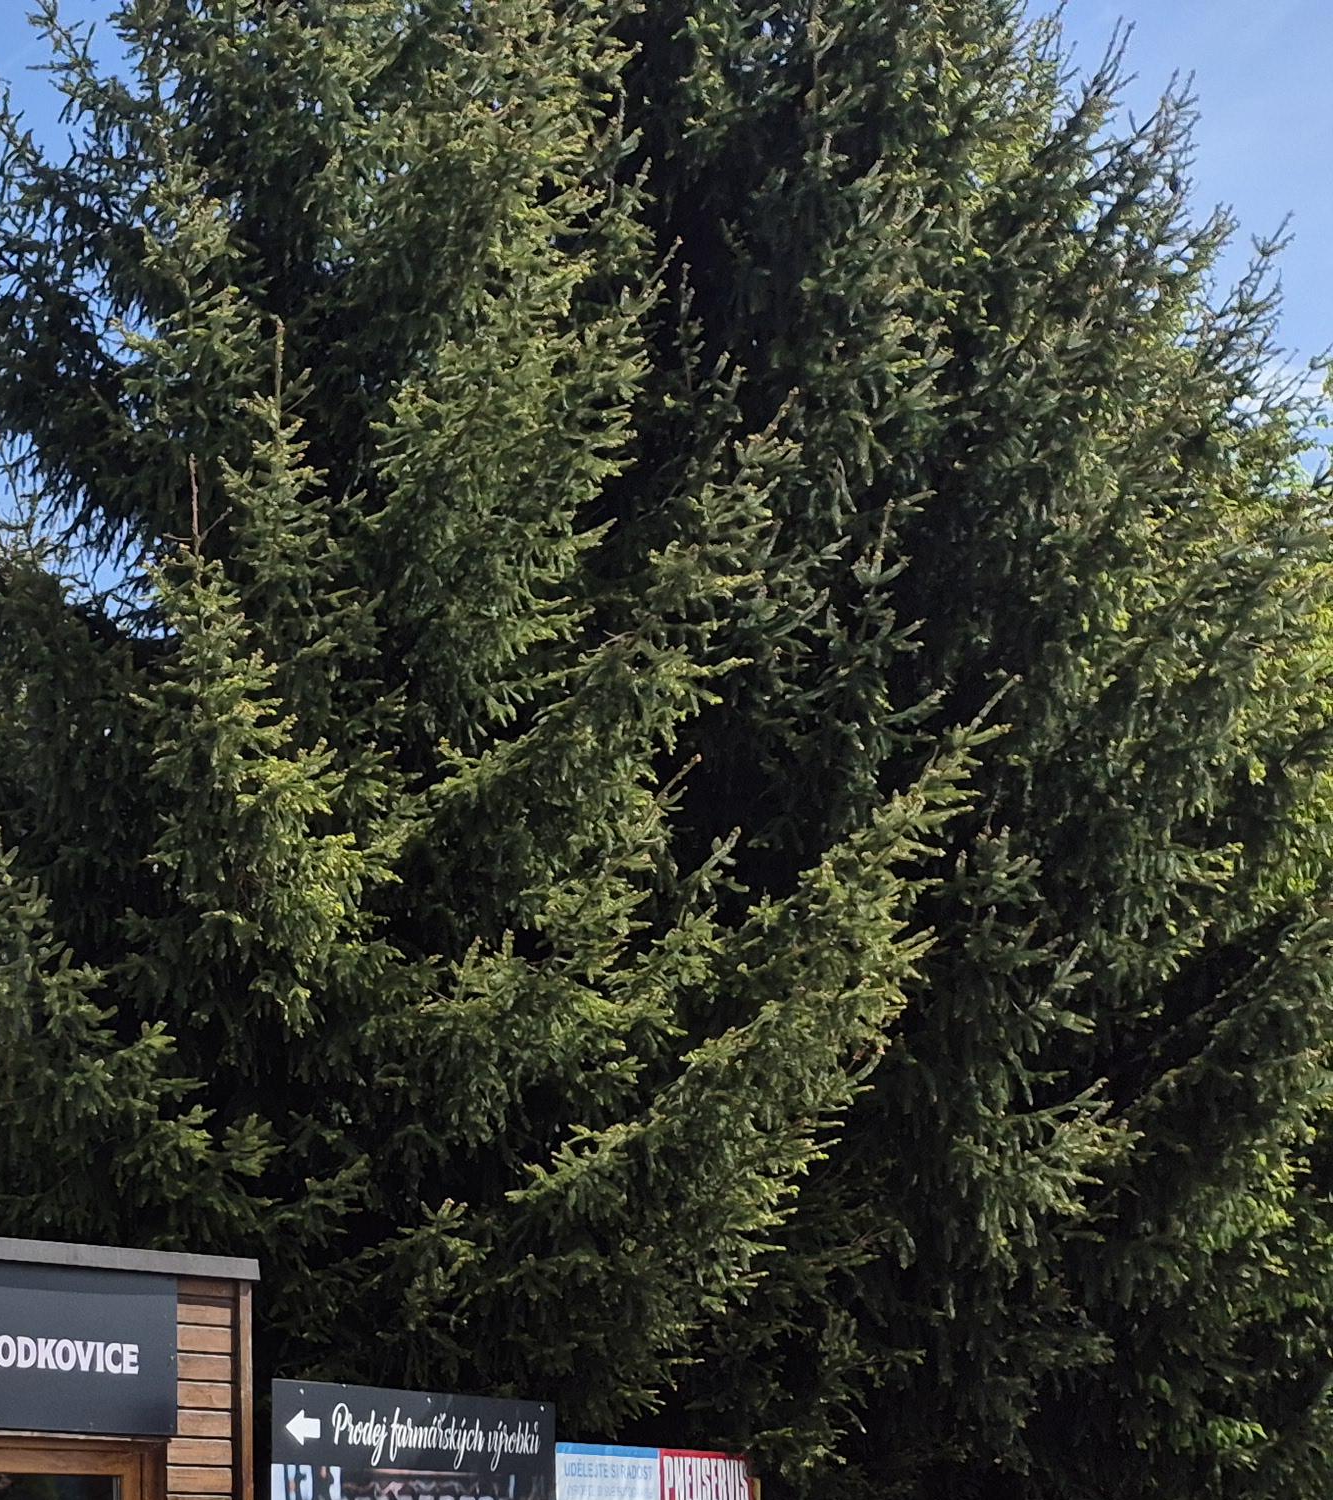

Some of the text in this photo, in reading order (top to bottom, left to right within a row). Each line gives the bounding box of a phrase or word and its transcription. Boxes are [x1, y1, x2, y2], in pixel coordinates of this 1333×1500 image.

[332, 1402, 541, 1472] Prodej farmářských výrobků
